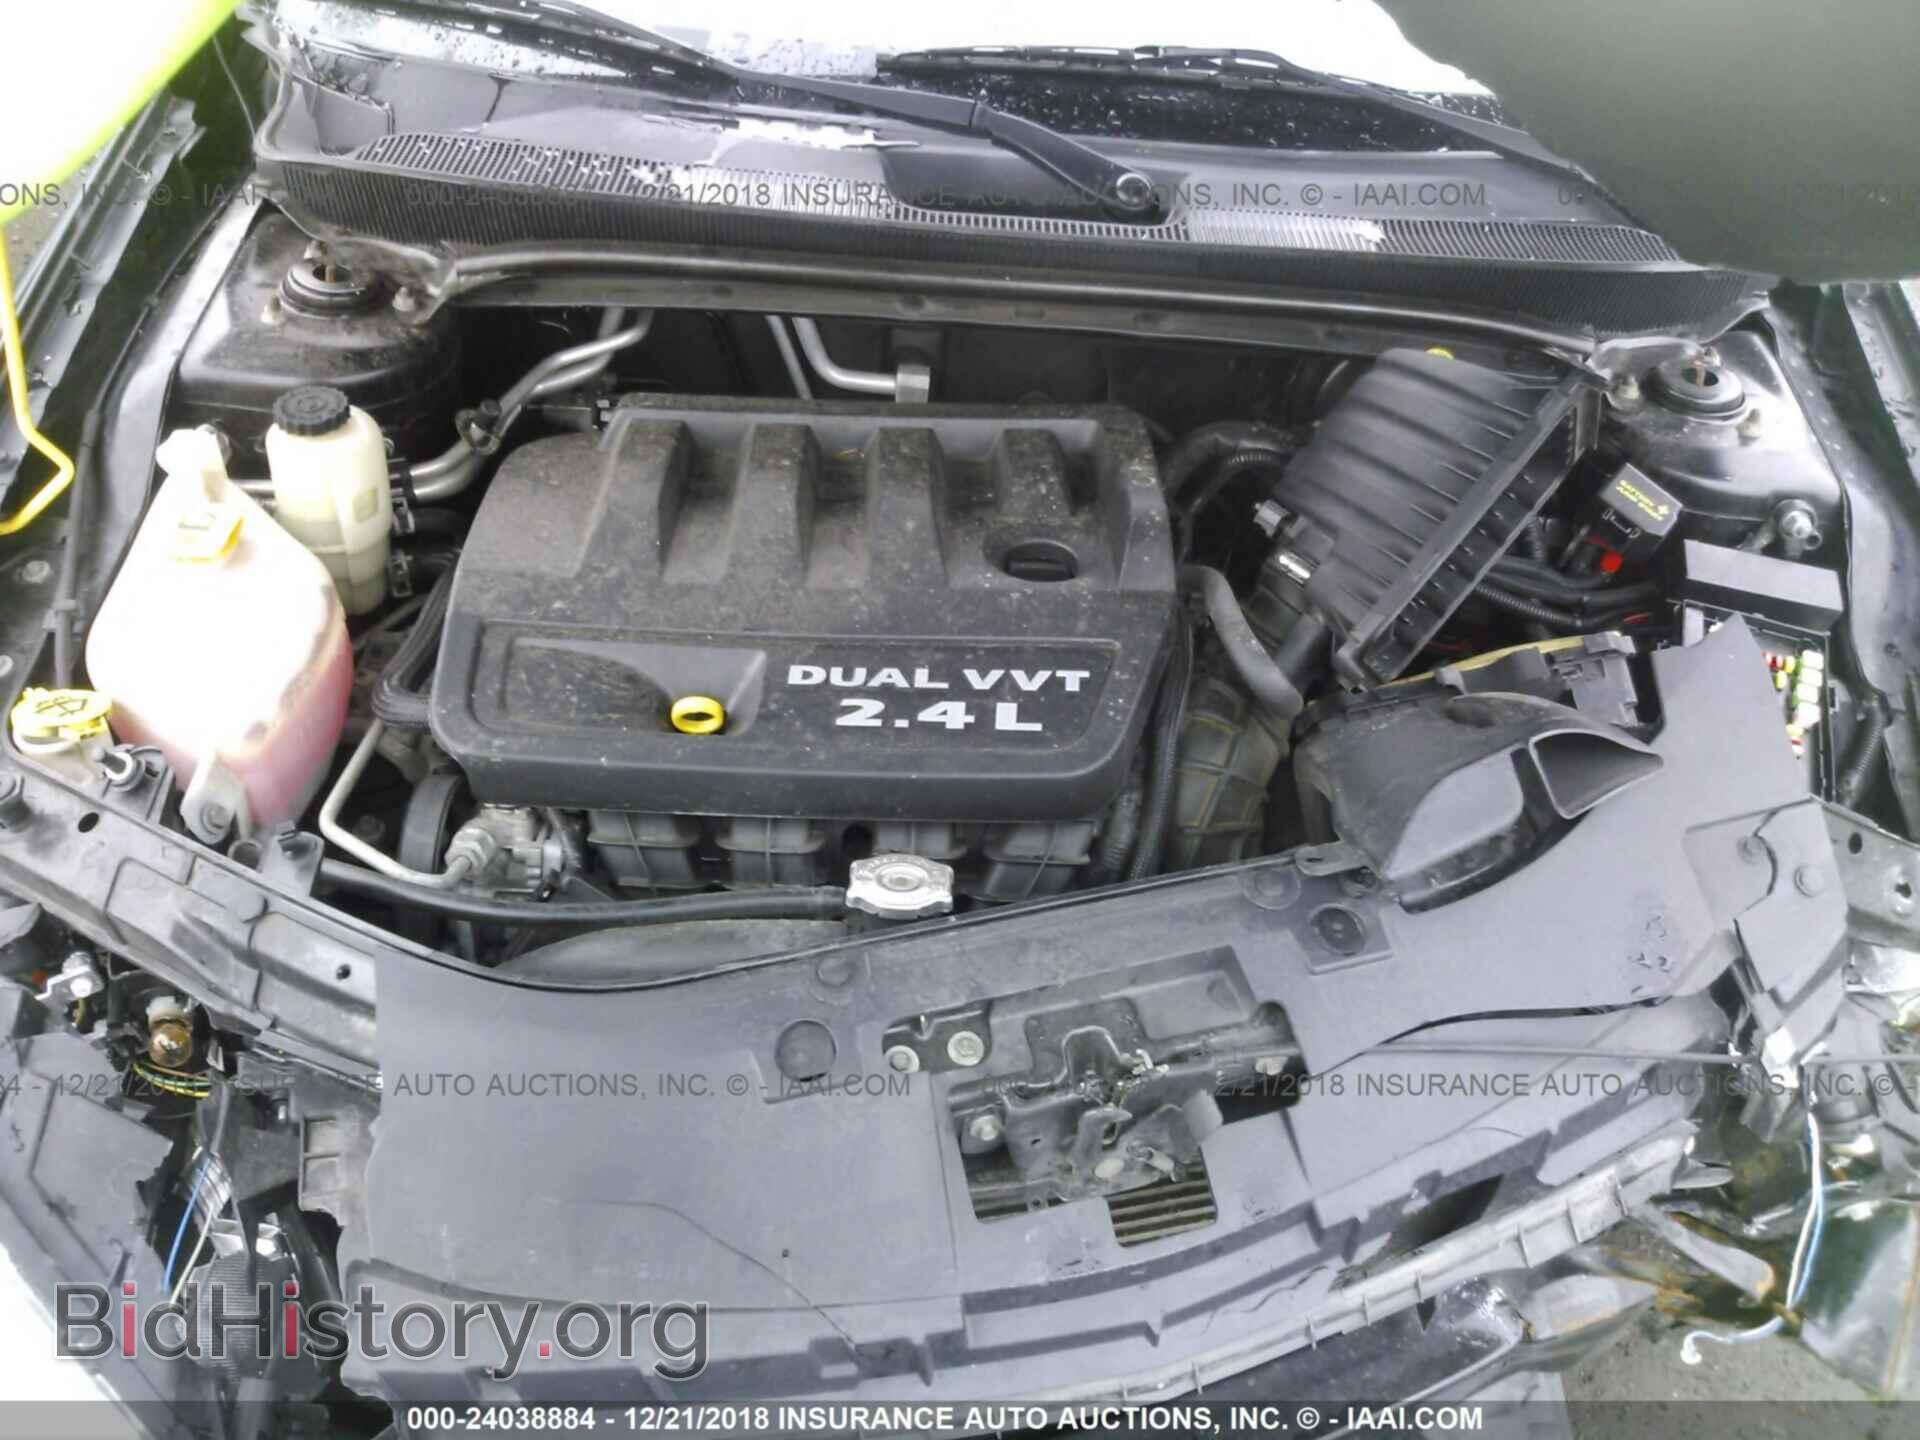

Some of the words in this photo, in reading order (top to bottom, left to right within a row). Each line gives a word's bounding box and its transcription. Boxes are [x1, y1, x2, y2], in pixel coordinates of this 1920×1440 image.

[787, 665, 949, 688] DUAL
[963, 669, 1090, 691] VVT
[835, 698, 975, 729] 2.4
[995, 702, 1042, 731] L
